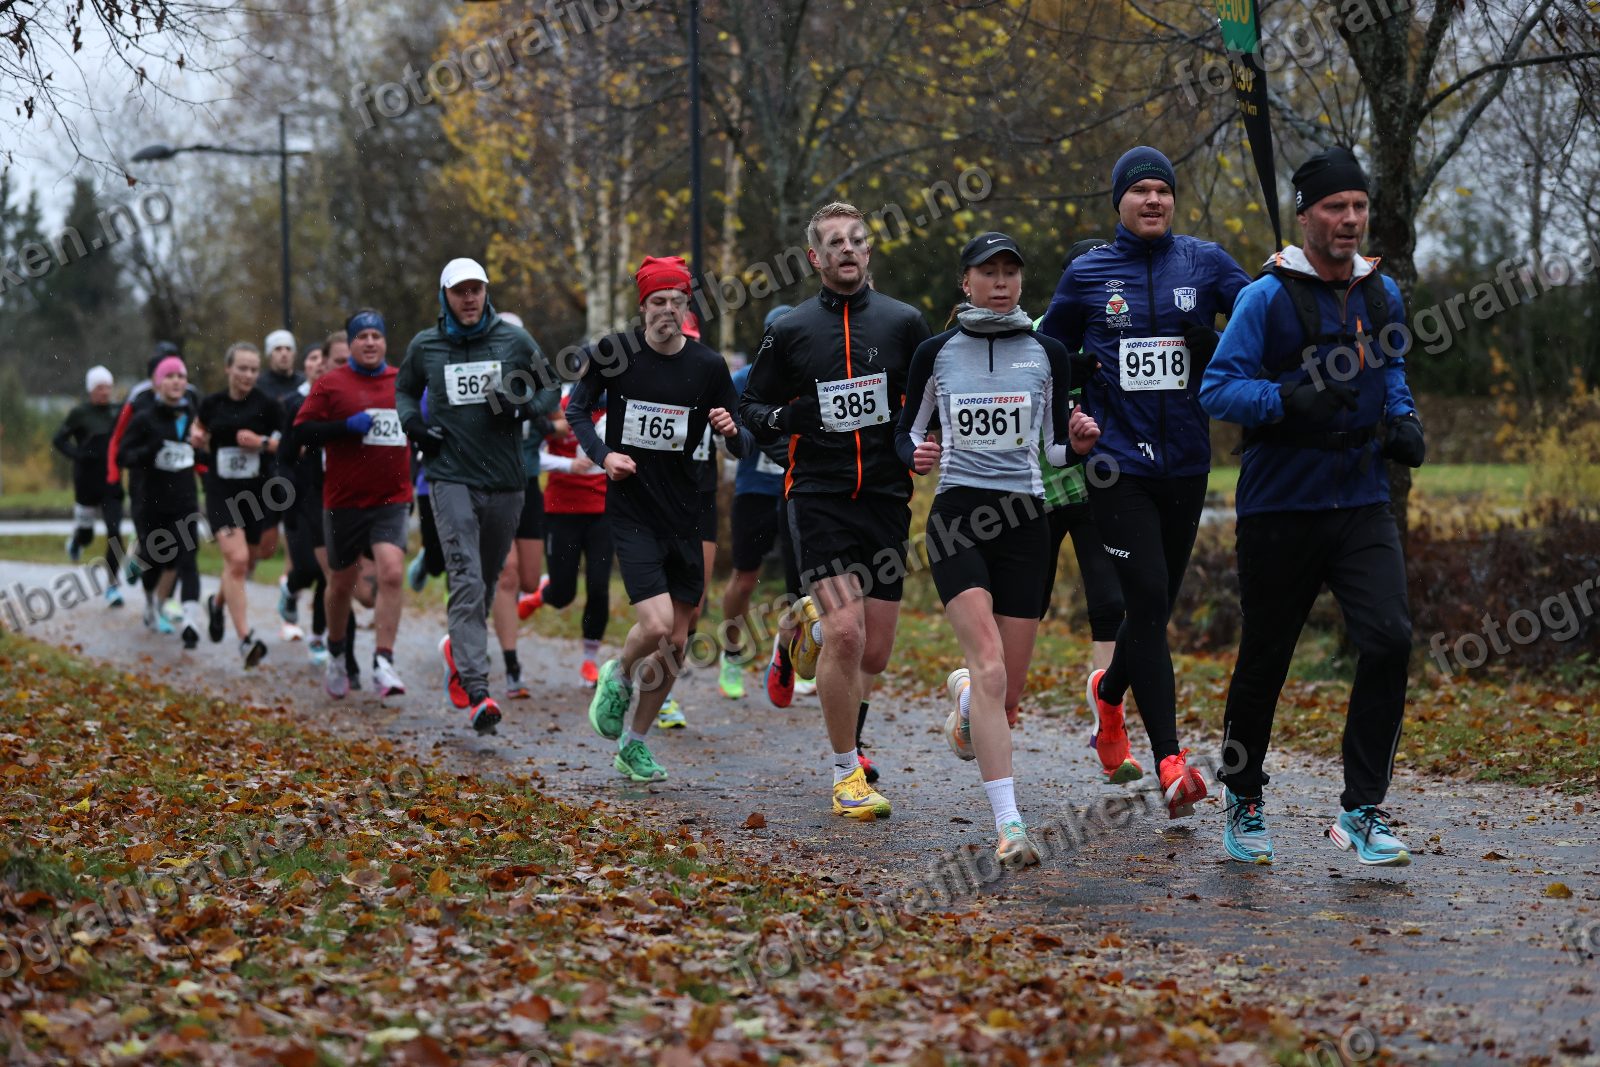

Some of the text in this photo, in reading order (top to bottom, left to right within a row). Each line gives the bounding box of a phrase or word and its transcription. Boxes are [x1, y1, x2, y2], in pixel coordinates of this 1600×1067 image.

[1126, 350, 1185, 377] 9518
[457, 374, 491, 395] 562
[823, 378, 882, 392] NORGESTESTEN
[632, 403, 685, 416] NORGESTESTEN
[832, 389, 876, 420] 385
[957, 396, 1025, 406] NORGESTESTEN
[372, 420, 399, 438] 824
[638, 414, 676, 440] 165
[957, 407, 1021, 437] 9361
